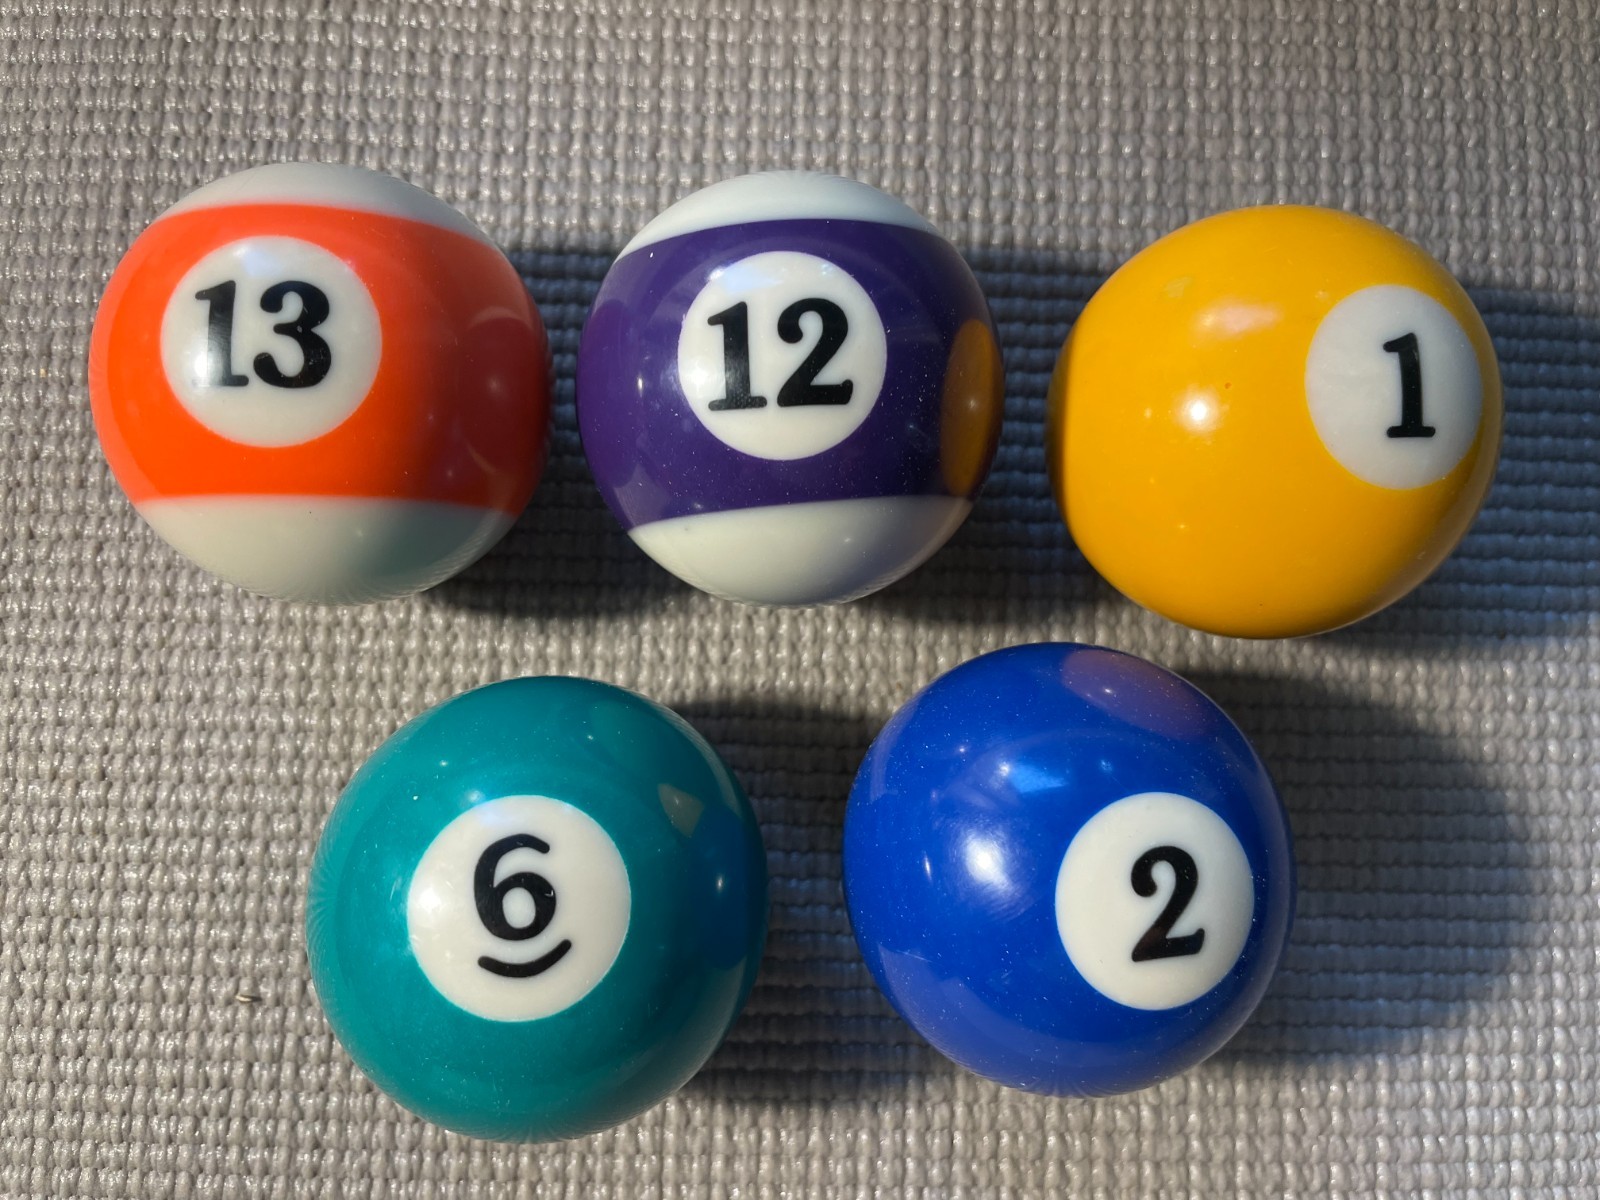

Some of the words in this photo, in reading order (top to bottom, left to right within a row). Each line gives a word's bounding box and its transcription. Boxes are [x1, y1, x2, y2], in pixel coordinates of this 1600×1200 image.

[194, 280, 332, 390] 13
[707, 298, 854, 410] 12
[1383, 332, 1436, 439] 1
[473, 833, 557, 942] 6
[1130, 845, 1206, 963] 2
